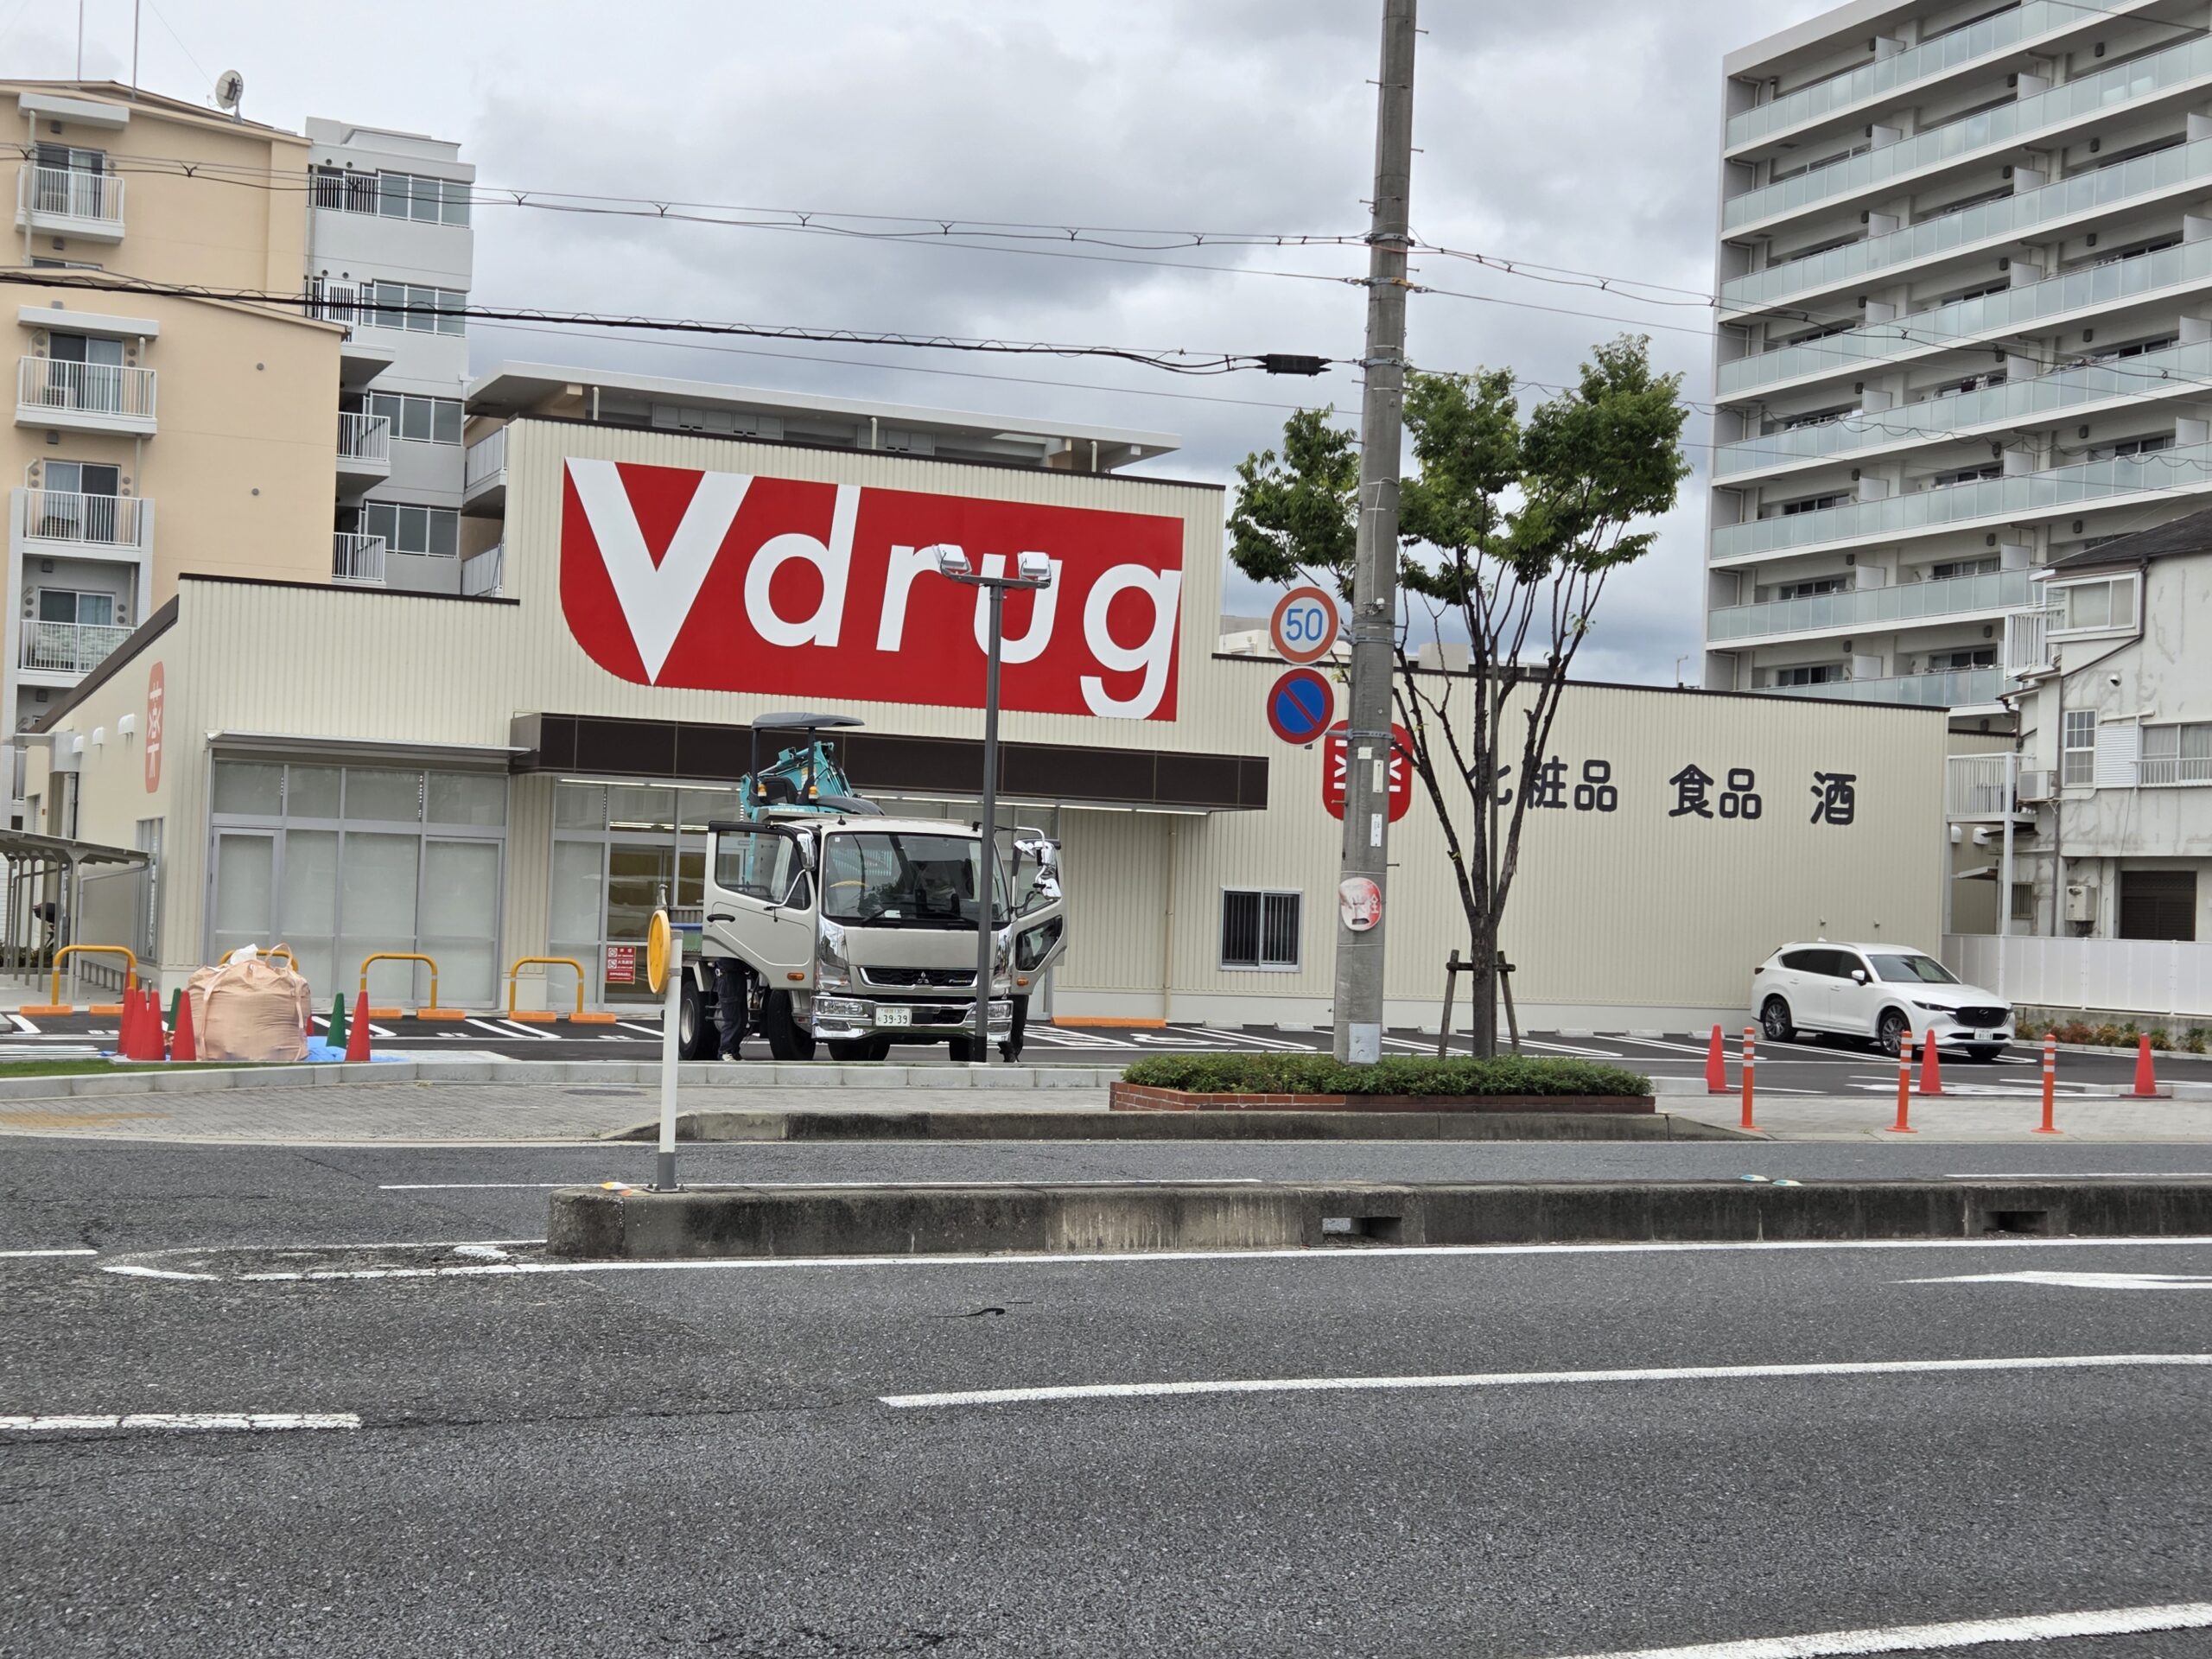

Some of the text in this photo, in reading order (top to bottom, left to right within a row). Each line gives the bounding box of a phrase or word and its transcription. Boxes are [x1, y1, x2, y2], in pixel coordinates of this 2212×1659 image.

[1286, 607, 1324, 642] 50
[1669, 764, 1762, 820] 食品
[1810, 771, 1857, 825] 酒
[883, 1014, 908, 1024] 39-39
